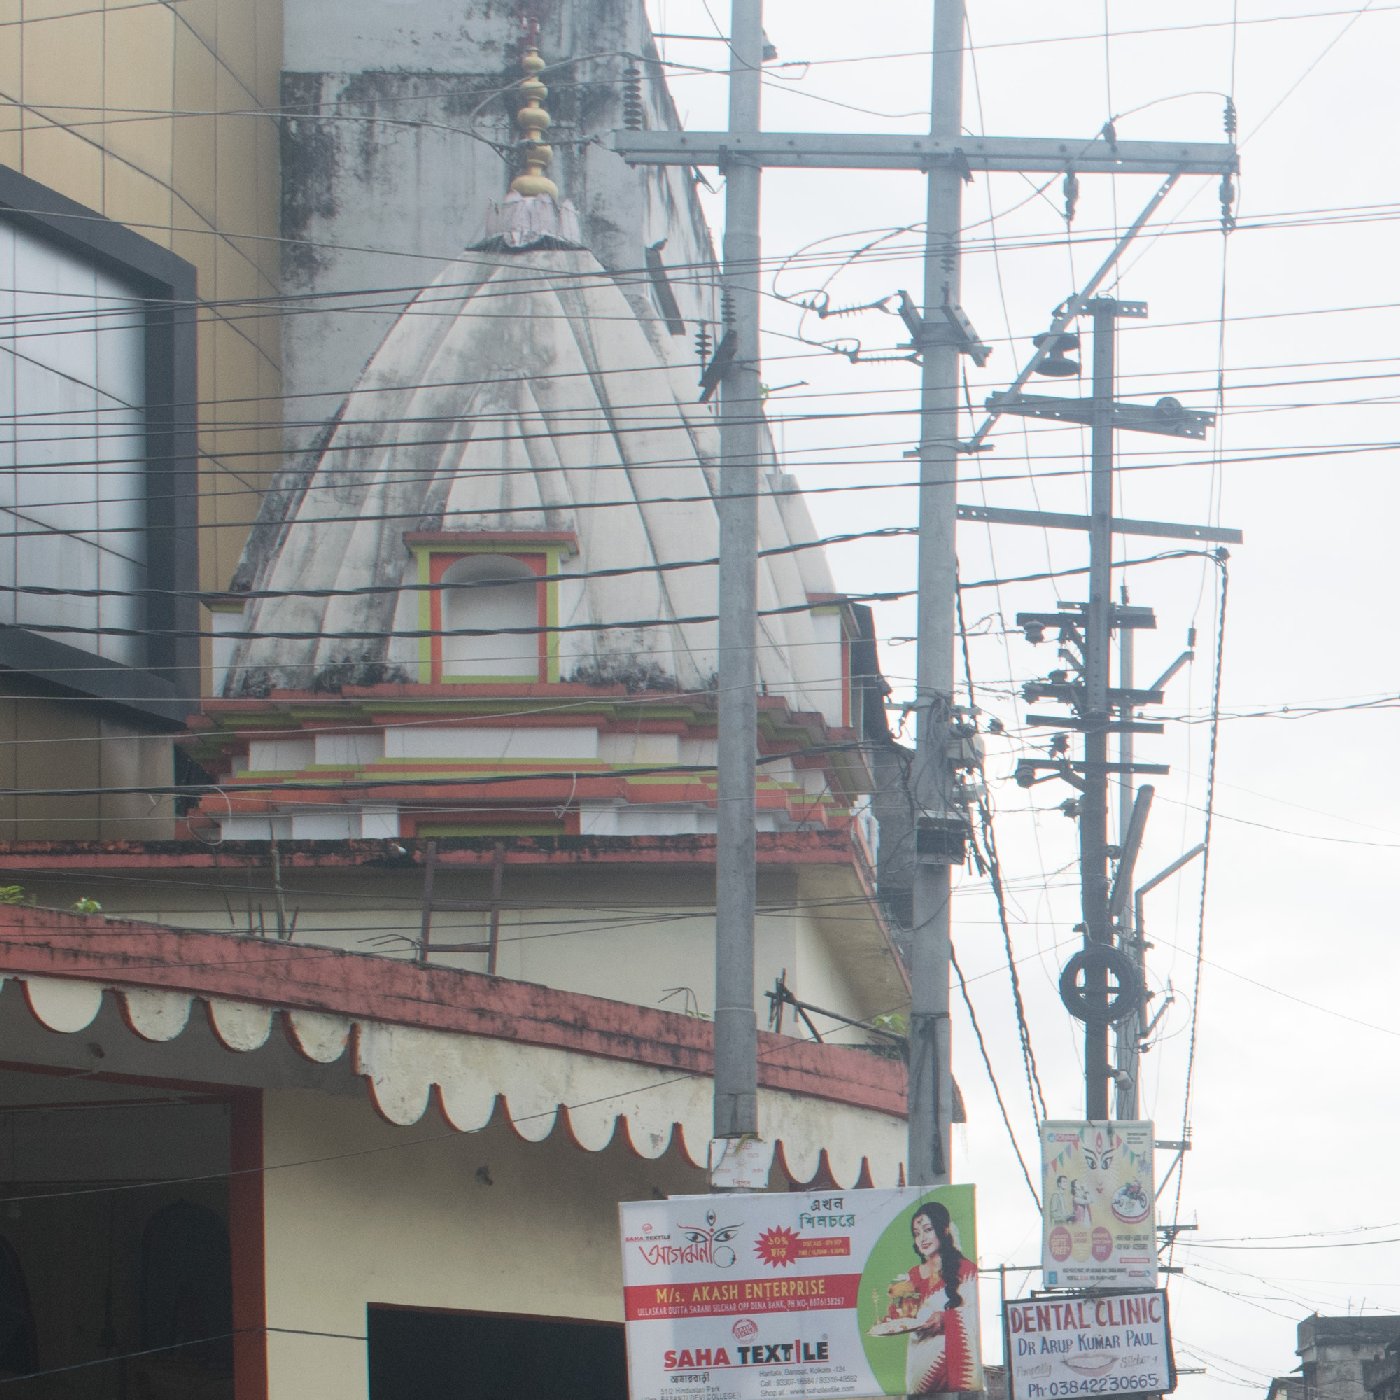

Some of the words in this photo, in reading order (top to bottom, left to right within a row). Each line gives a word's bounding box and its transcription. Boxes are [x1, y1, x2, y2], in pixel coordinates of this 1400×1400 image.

[811, 1197, 844, 1212] এখন
[800, 1213, 857, 1230] শিলচরে
[656, 1289, 685, 1303] M/s.
[692, 1283, 739, 1301] AKASH
[745, 1280, 826, 1299] ENTERPRISE
[1010, 1302, 1091, 1334] DENTAL
[1095, 1297, 1162, 1327] CLINIC
[664, 1346, 730, 1368] SAHA
[737, 1338, 830, 1364] TEXTILE
[1040, 1336, 1074, 1355] ARUP
[1078, 1333, 1121, 1351] KUMAR
[1126, 1329, 1159, 1347] PAUL
